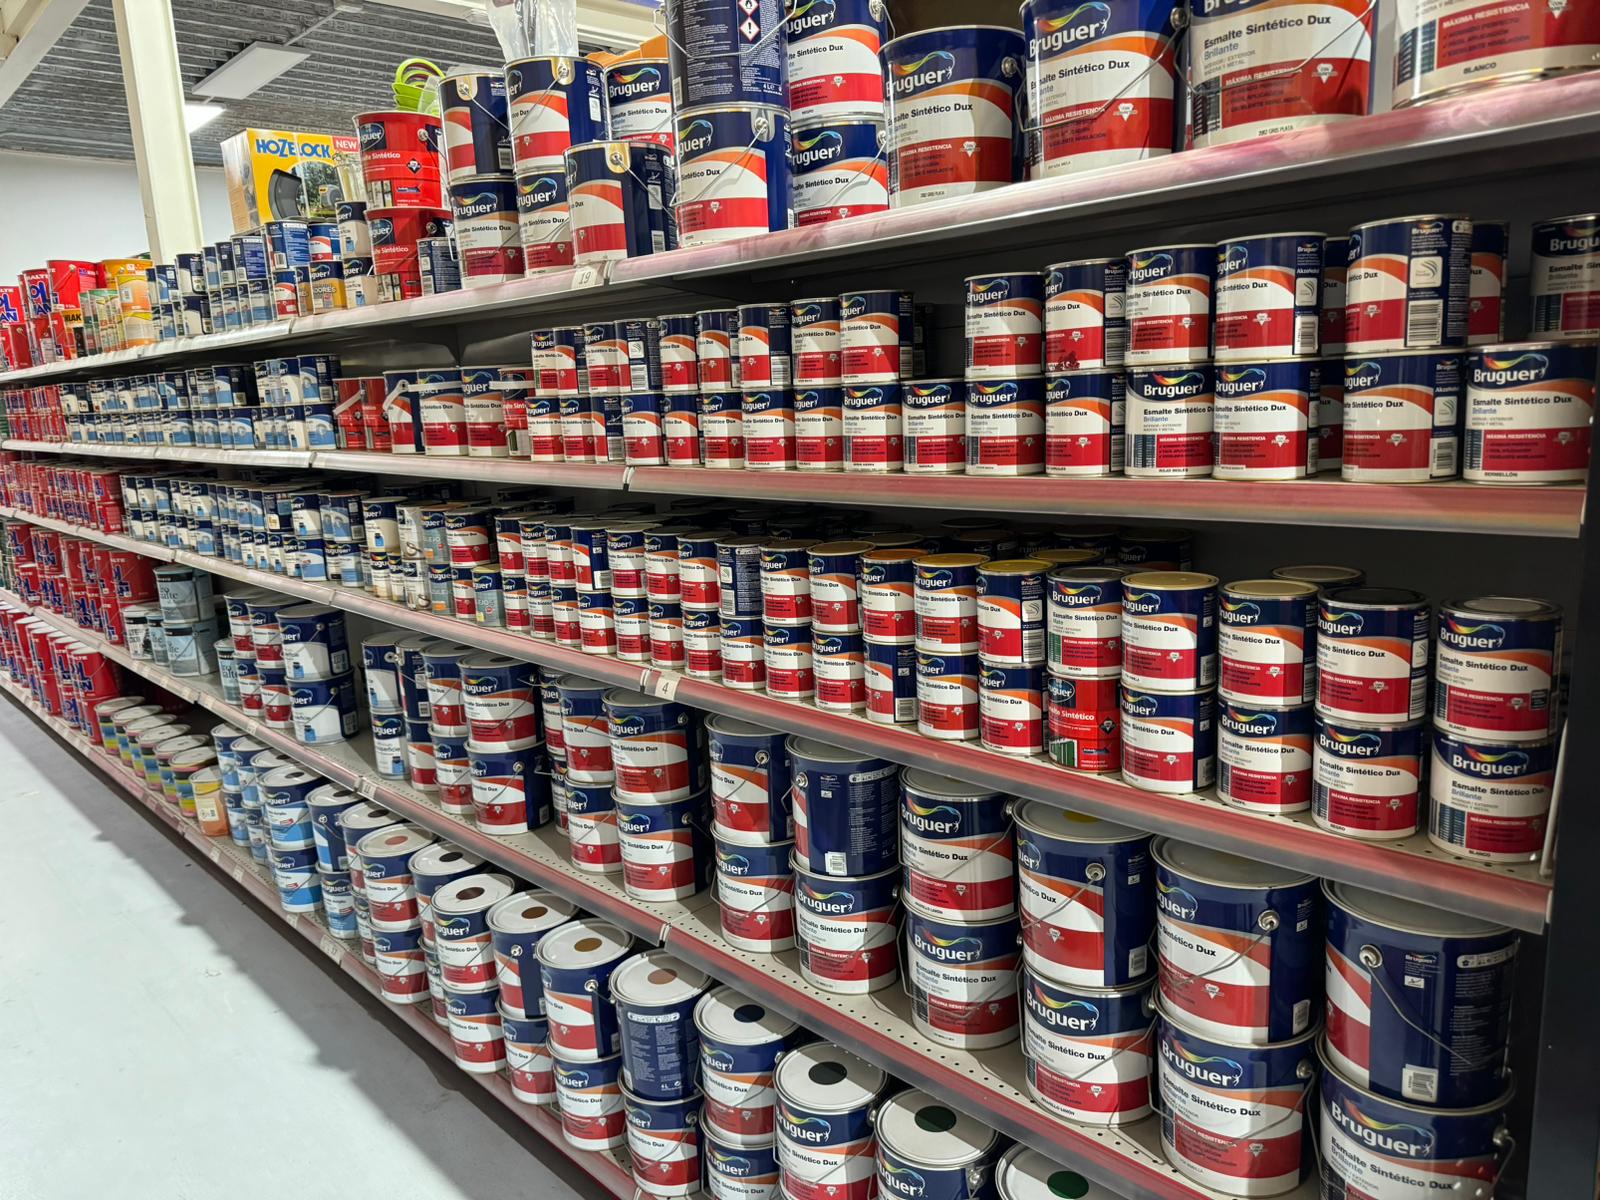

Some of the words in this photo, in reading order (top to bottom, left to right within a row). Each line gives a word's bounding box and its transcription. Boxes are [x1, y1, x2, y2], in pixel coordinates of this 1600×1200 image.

[1442, 15, 1472, 29] MÁXIMA
[1474, 2, 1530, 24] RESISTENCIA
[1203, 29, 1242, 50] Esmalte
[1246, 18, 1303, 35] Sintético
[1307, 15, 1331, 25] Dux
[1029, 22, 1100, 59] Bruguer
[797, 46, 828, 57] Sintético
[829, 43, 844, 51] Dux
[1204, 41, 1239, 61] Brillante
[1058, 62, 1105, 79] Sintético
[1108, 59, 1130, 69] Dux
[1463, 62, 1497, 74] BLANCO
[885, 68, 945, 97] Bruguer
[1225, 75, 1251, 86] MÁXIMA
[609, 83, 655, 97] Bruguer
[911, 102, 952, 117] Sintético
[953, 102, 973, 111] Dux
[335, 139, 358, 151] NEW
[917, 143, 952, 153] RESISTENCIA
[805, 180, 833, 189] Sintético
[453, 197, 492, 217] Bruguer
[380, 246, 409, 254] Sintético
[1364, 271, 1378, 279] Dux
[1251, 281, 1267, 289] Dux
[966, 290, 1003, 303] Bruguer
[1142, 289, 1175, 297] Sintético
[1473, 368, 1538, 384] Bruguer
[1144, 384, 1199, 397] Bruguer
[1216, 380, 1259, 392] Bruguer
[844, 393, 880, 407] Bruguer
[906, 393, 946, 405] Bruguer
[970, 391, 1013, 403] Bruguer
[1472, 398, 1502, 406] Esmalte
[1504, 397, 1550, 405] Sintético
[1143, 408, 1172, 416] Esmalte
[1174, 406, 1206, 415] Sintético
[1234, 405, 1268, 413] Sintético
[1351, 400, 1383, 409] Sintético
[1386, 400, 1403, 408] Dux
[1074, 409, 1088, 417] Dux
[915, 577, 947, 589] Bruguer
[1052, 590, 1096, 604] Bruguer
[1052, 612, 1073, 620] Esmalte
[1133, 623, 1162, 631] Sintético
[1232, 635, 1263, 644] Sintético
[1265, 637, 1280, 645] Dux
[1440, 627, 1495, 649] Bruguer
[1331, 646, 1366, 657] Sintético
[1439, 653, 1463, 666] Esmalte
[1465, 659, 1508, 672] Sintético
[1510, 664, 1528, 672] Dux
[662, 683, 669, 694] 4
[1061, 710, 1094, 721] Sintético
[1132, 726, 1160, 735] Sintético
[1221, 715, 1269, 734] Bruguer
[1222, 737, 1243, 749] Esmalte
[1245, 745, 1279, 754] Sintético
[1319, 733, 1373, 756] Bruguer
[1319, 758, 1344, 772] Esmalte
[1345, 765, 1383, 776] Sintético
[1452, 755, 1520, 775] Bruguer
[1452, 780, 1487, 794] Esmalte
[1490, 786, 1529, 796] Sintético
[901, 808, 952, 834] Bruguer
[918, 846, 950, 860] Sintético
[952, 852, 968, 861] Dux
[1469, 849, 1490, 857] BLANCO
[798, 890, 847, 913] Bruguer
[1040, 893, 1057, 904] Dux
[819, 924, 851, 933] Sintético
[914, 935, 973, 961] Bruguer
[1163, 926, 1194, 950] Sintético
[1196, 944, 1216, 957] Dux
[916, 961, 940, 979] Esmalte
[942, 970, 979, 983] Sintético
[981, 975, 996, 983] Dux
[1026, 988, 1090, 1031] Bruguer
[1048, 1039, 1085, 1060] Sintético
[1087, 1051, 1105, 1061] Dux
[1162, 1039, 1231, 1086] Bruguer
[1163, 1071, 1189, 1101] Esmalte
[1191, 1093, 1237, 1115] Sintético
[1239, 1108, 1261, 1117] Dux
[1331, 1100, 1421, 1157] Bruguer
[792, 1150, 821, 1165] Sintético
[1331, 1145, 1363, 1175] Brillante
[1331, 1136, 1367, 1167] Esmalte
[1370, 1163, 1425, 1188] Sintético
[1429, 1180, 1453, 1190] Dux
[878, 1166, 917, 1196] uguer
